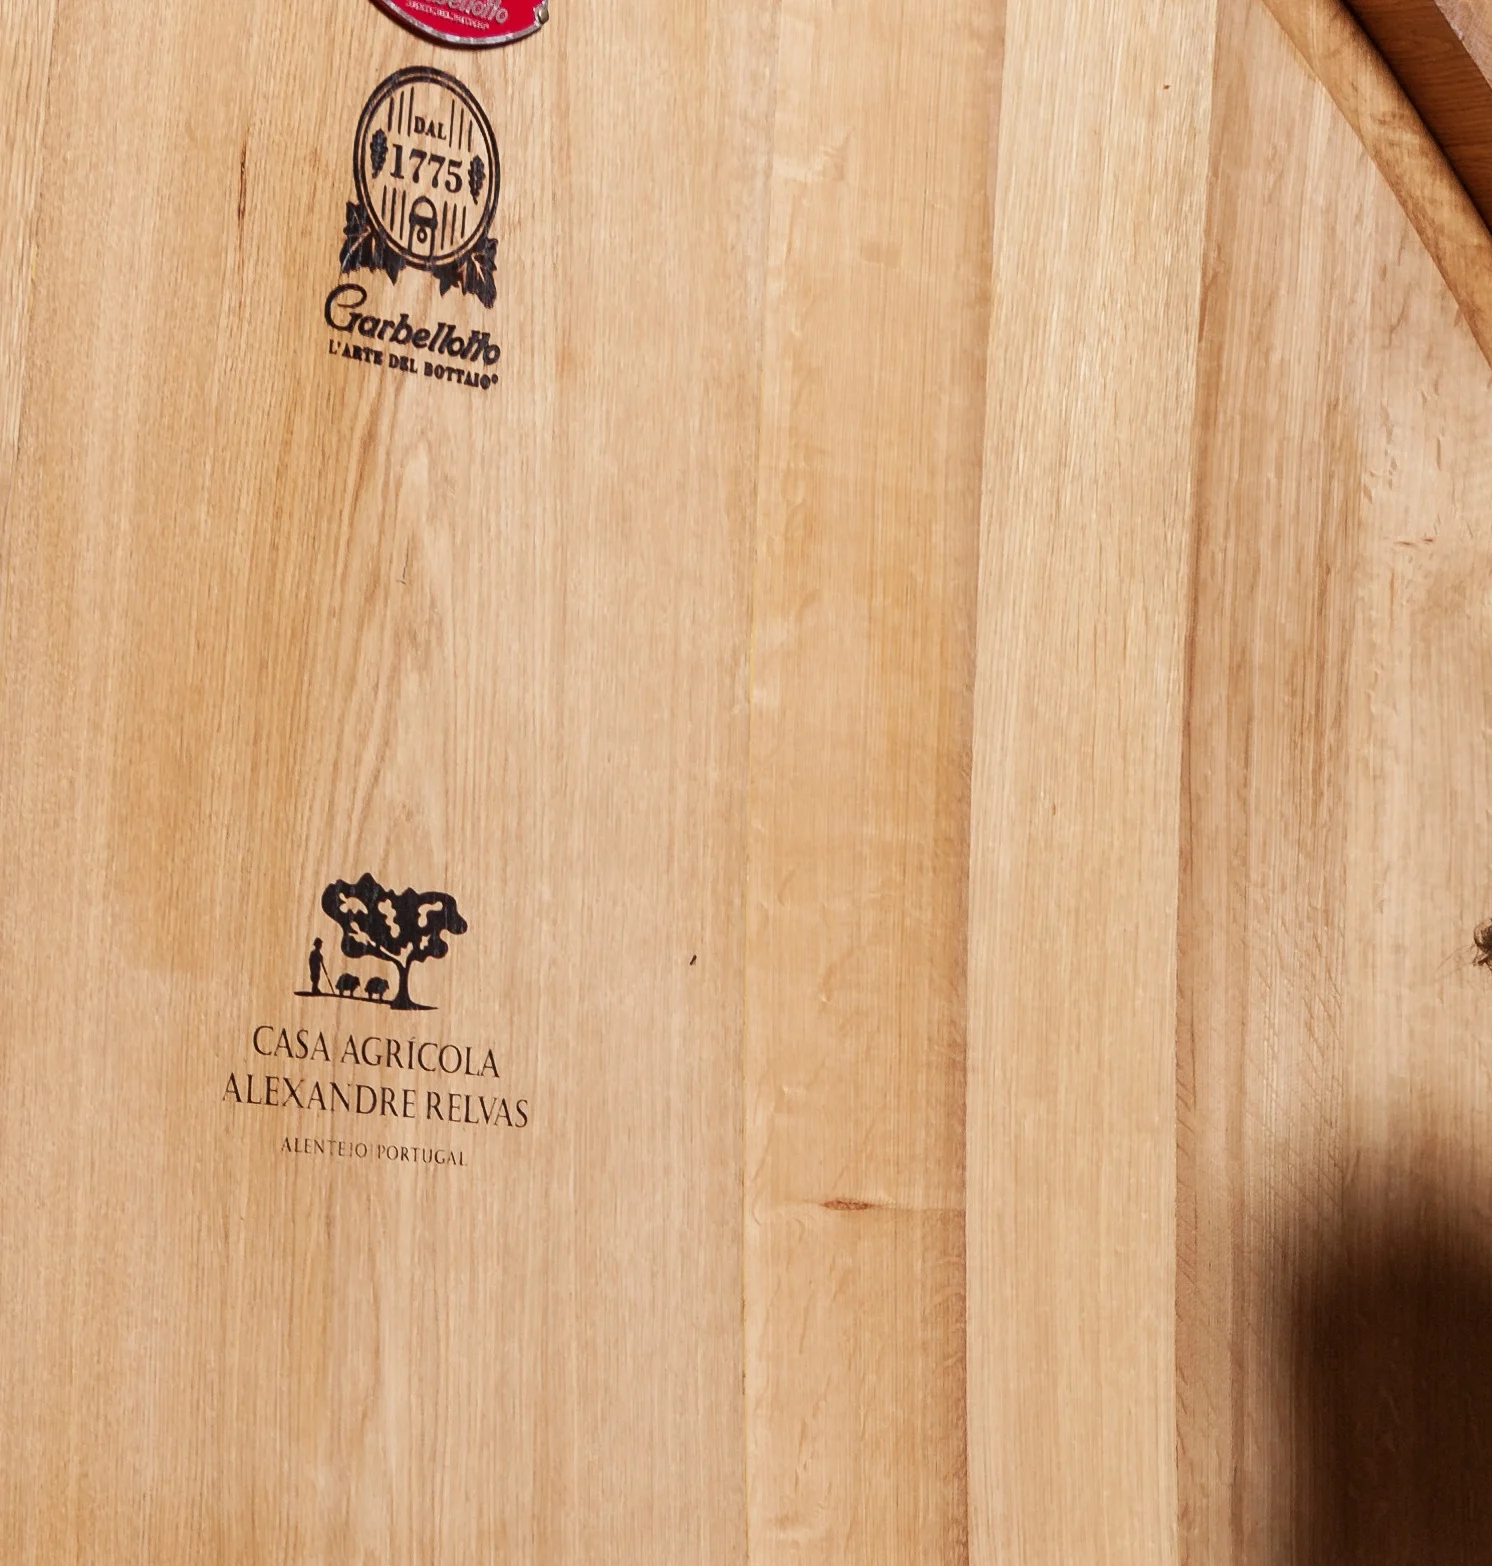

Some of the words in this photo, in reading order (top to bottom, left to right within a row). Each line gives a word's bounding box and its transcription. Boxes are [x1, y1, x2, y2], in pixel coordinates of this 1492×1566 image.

[413, 116, 447, 140] DAL
[390, 144, 463, 194] 1775
[324, 283, 501, 366] Garbellotto
[329, 339, 383, 366] L'ARTE
[388, 353, 418, 374] DEL
[253, 1024, 331, 1062] CASA
[340, 1034, 500, 1079] AGRÍCOLA
[222, 1071, 417, 1119] ALEXANDRE
[426, 1091, 529, 1129] RELVAS
[281, 1136, 368, 1159] ALENTEJO
